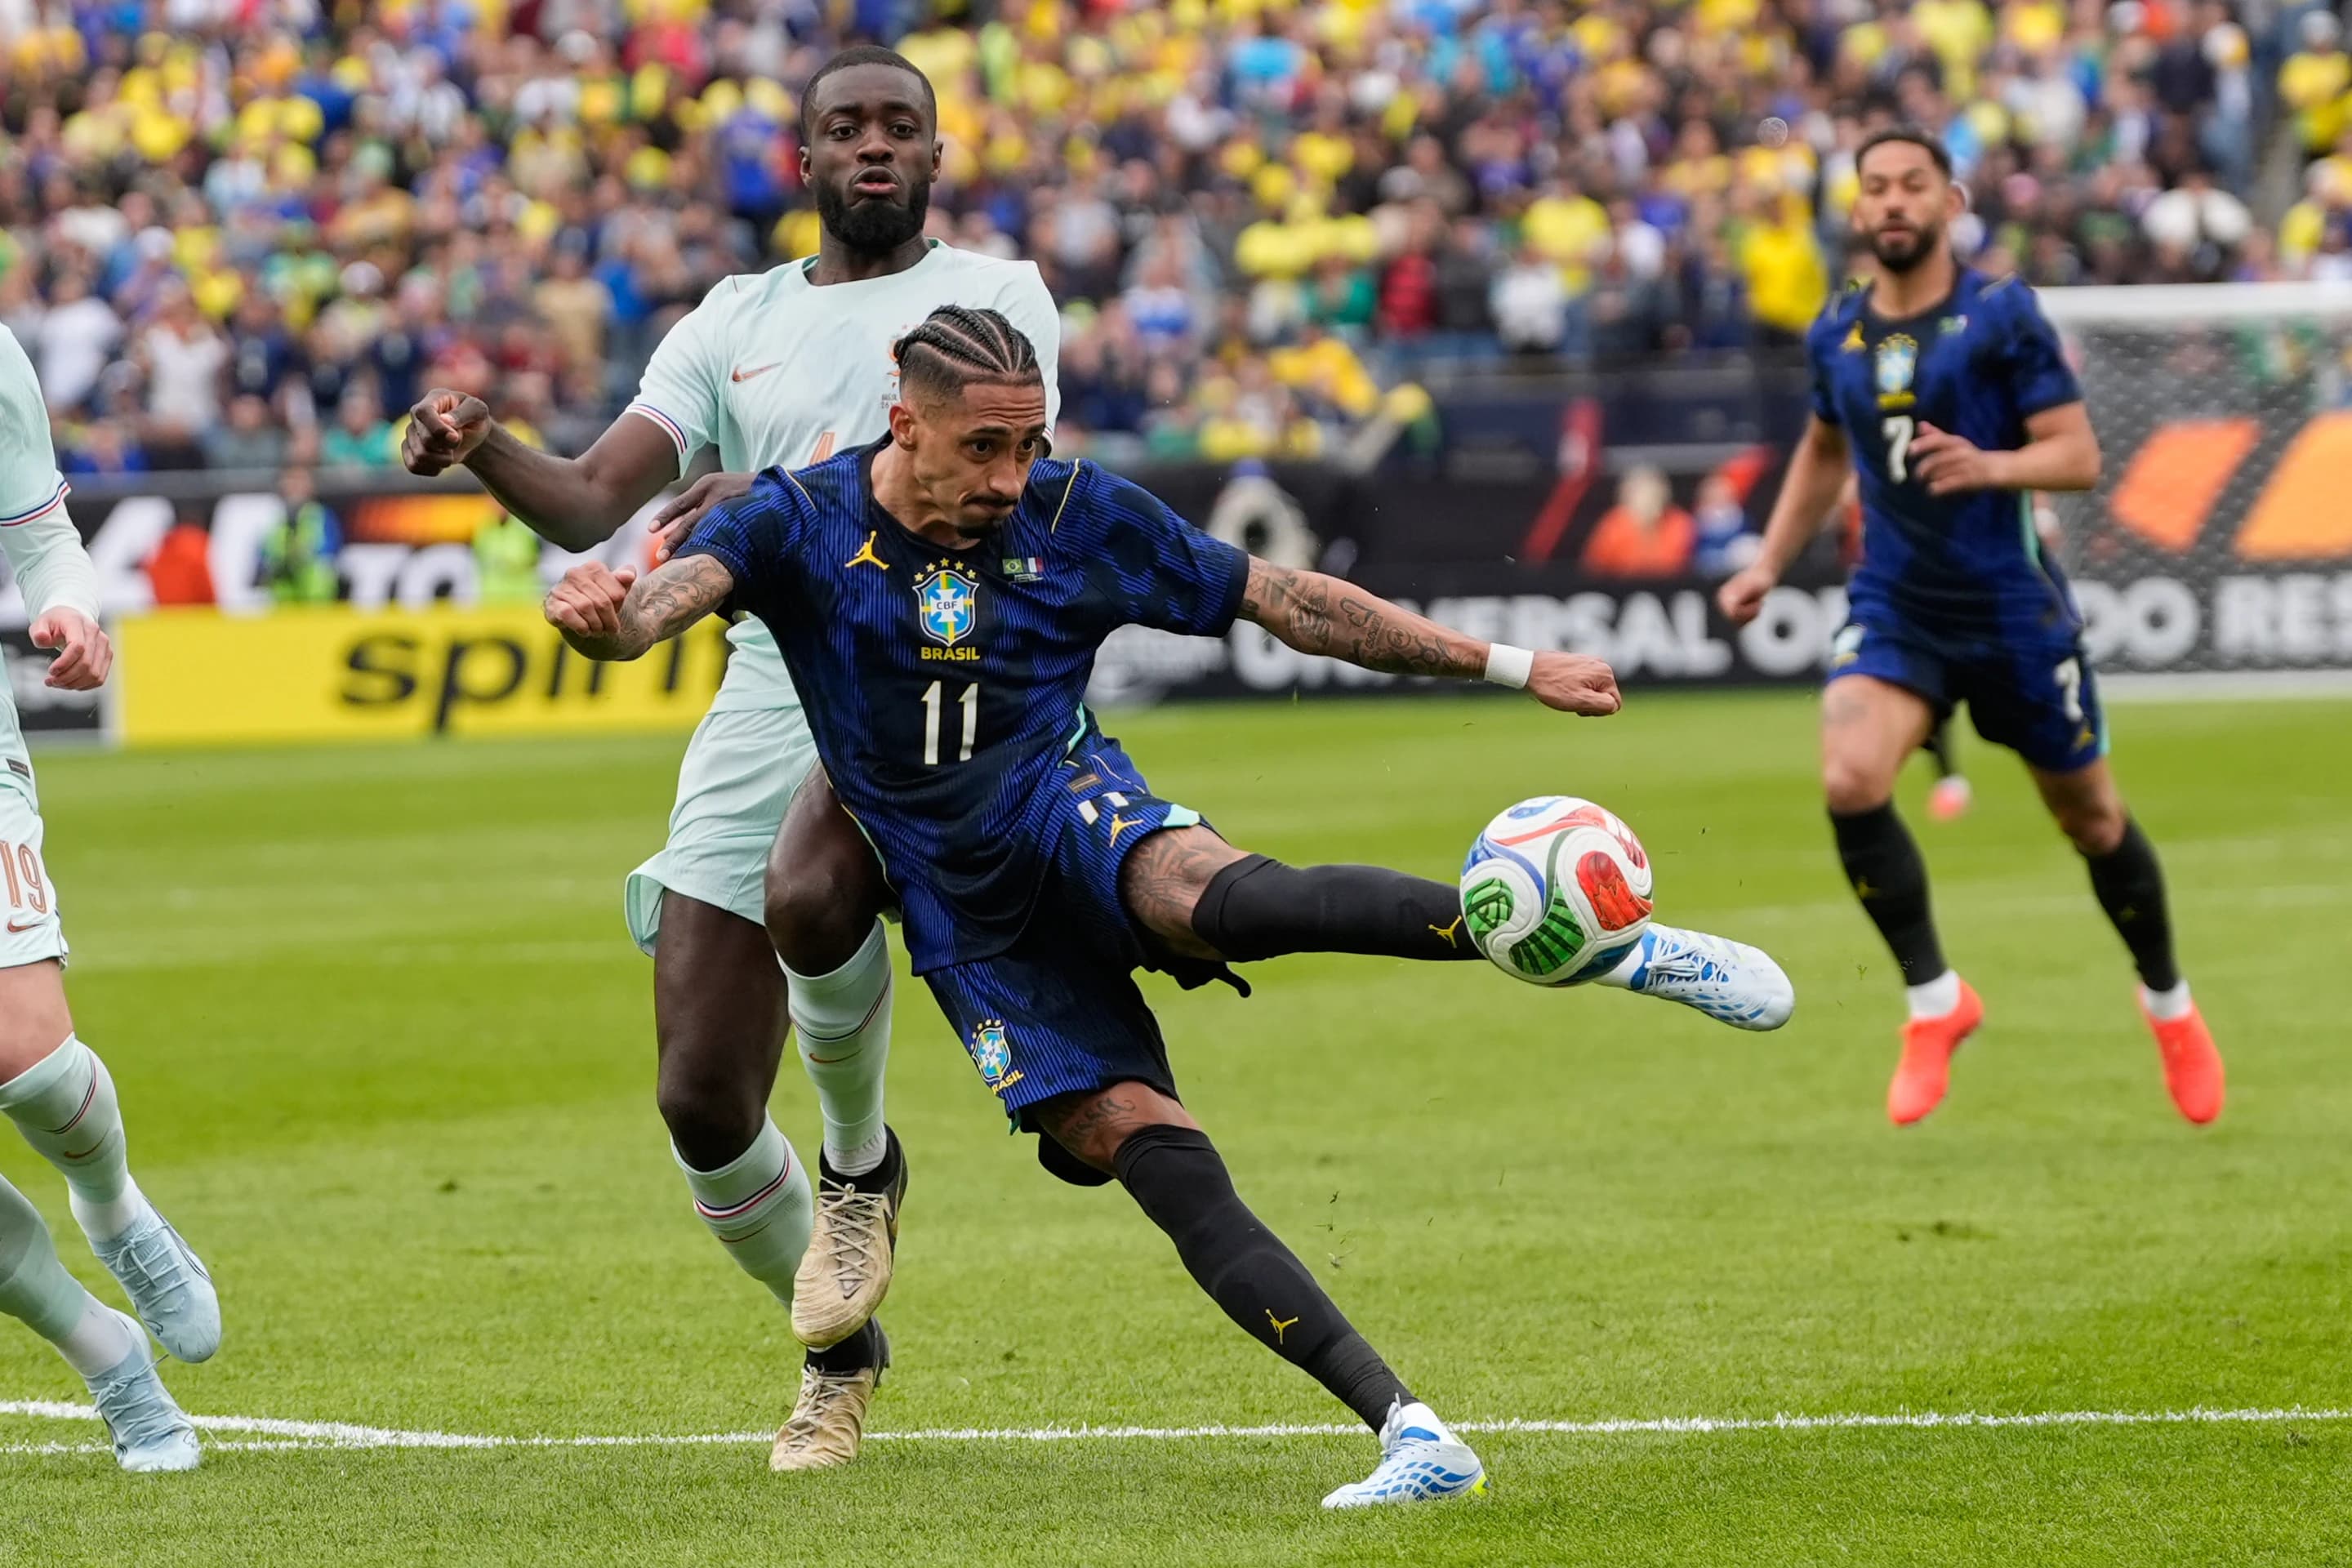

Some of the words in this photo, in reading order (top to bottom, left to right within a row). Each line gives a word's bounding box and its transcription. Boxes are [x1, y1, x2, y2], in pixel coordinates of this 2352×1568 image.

[1883, 414, 1914, 483] 7
[936, 601, 957, 610] CBF
[921, 646, 980, 661] BRASIL
[2054, 657, 2082, 722] 7
[921, 680, 978, 765] 11
[0, 840, 47, 914] 19
[991, 1070, 1024, 1095] RASIL
